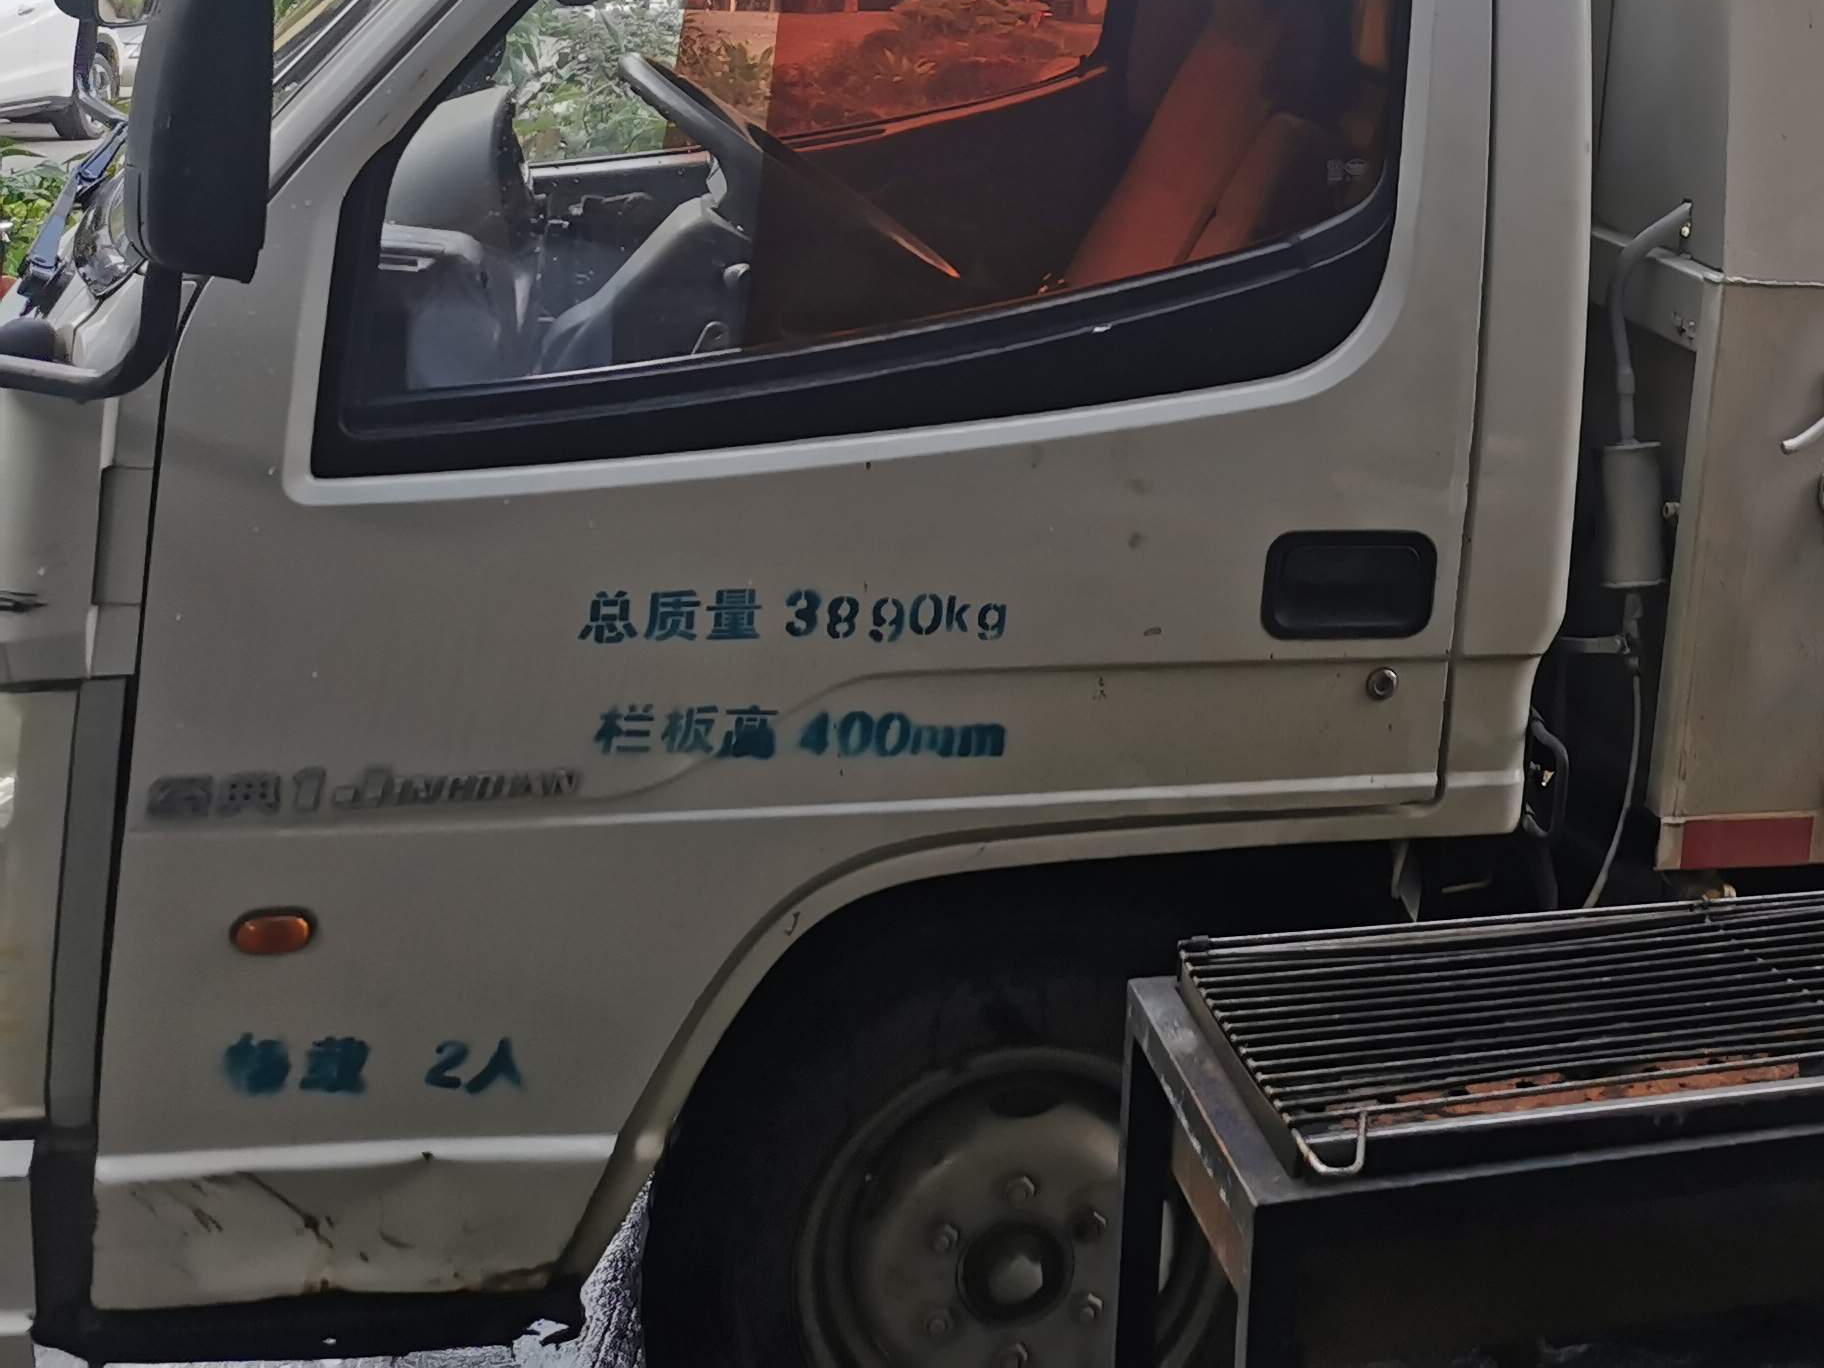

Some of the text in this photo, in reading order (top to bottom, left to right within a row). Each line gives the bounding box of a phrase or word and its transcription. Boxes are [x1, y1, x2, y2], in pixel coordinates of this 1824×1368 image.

[577, 588, 1008, 644] 总质量 3890kg
[594, 703, 1007, 760] 栏板高 400mm
